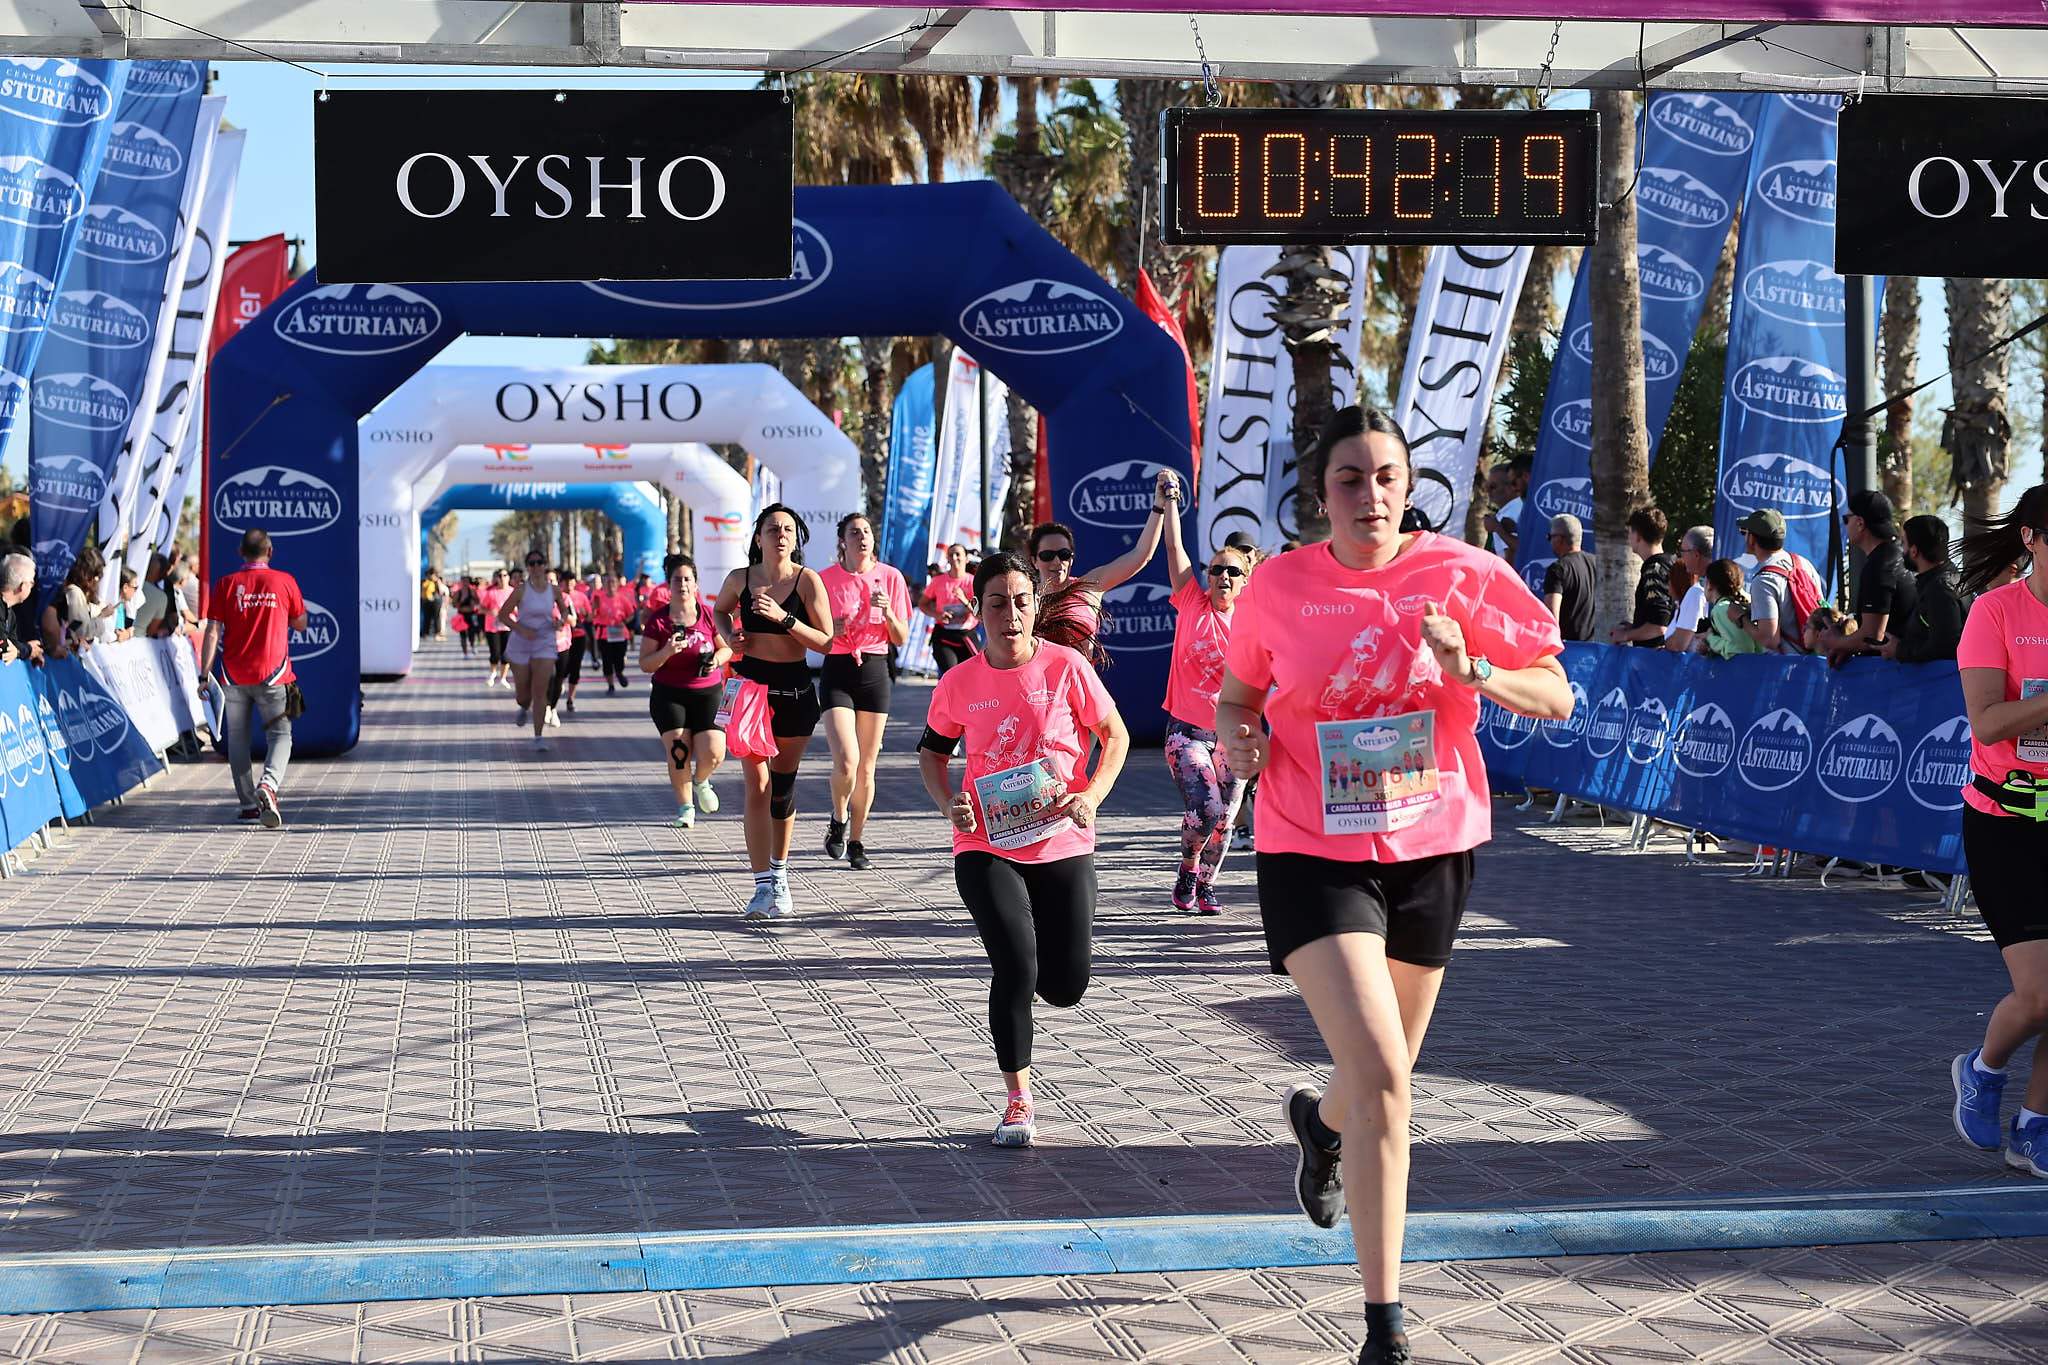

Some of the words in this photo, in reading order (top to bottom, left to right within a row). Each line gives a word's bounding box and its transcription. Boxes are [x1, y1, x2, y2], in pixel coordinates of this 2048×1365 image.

[0, 78, 99, 116] STURIANA
[1656, 101, 1746, 150] ASTURIANA
[397, 152, 726, 221] OYSHO
[1197, 132, 1565, 219] 00:42:19
[284, 307, 428, 337] ASTURIANA
[974, 310, 1114, 338] ASTURIANA
[495, 382, 703, 422] OYSHO
[1739, 372, 1847, 411] ASTURIANA
[370, 430, 433, 443] OYSHO
[762, 424, 823, 438] OYSHO
[1729, 471, 1832, 508] ASTURIANA
[219, 493, 333, 520] ASTURIANA
[361, 599, 401, 612] SHO
[1301, 603, 1355, 617] OYSHO
[968, 699, 1000, 713] OYSHO
[1741, 736, 1804, 773] ASTURIANA
[1820, 744, 1894, 782] ASTURIANA
[1010, 797, 1042, 818] 016
[1331, 803, 1361, 813] CARRERA
[1337, 817, 1377, 828] OYSHO
[1000, 836, 1027, 849] OYSHO
